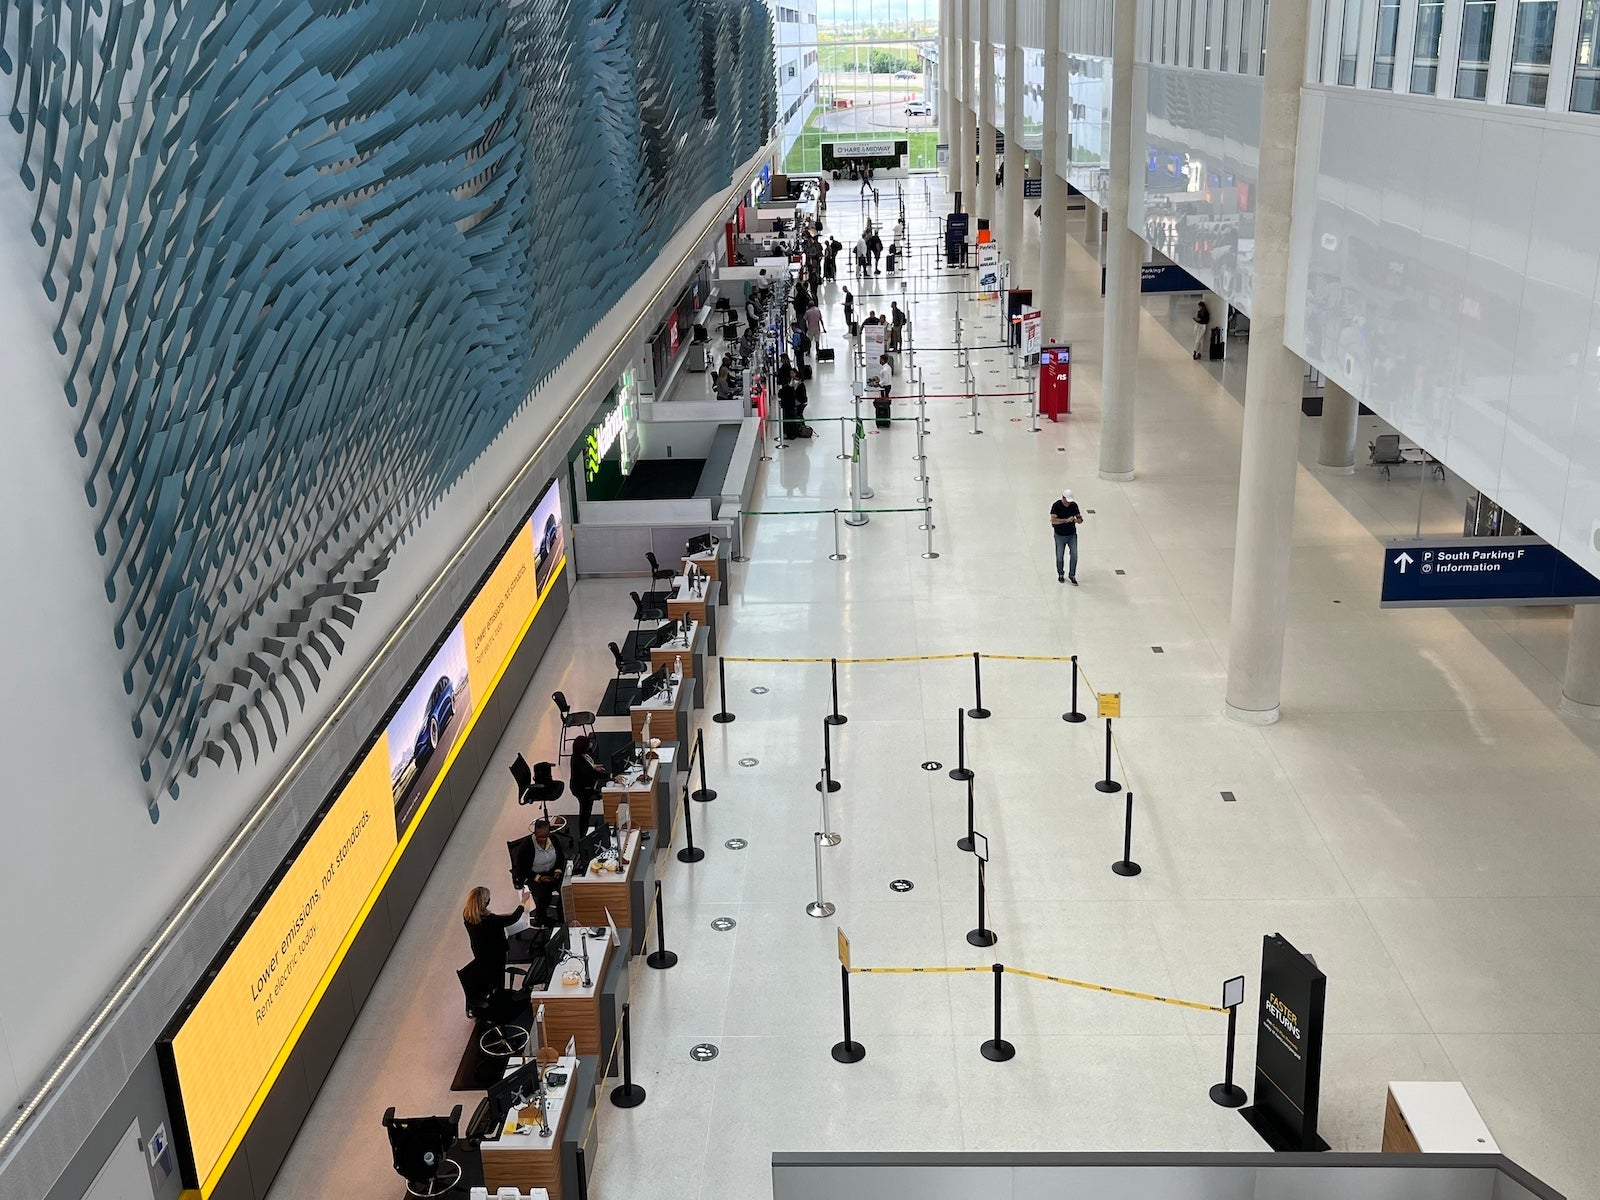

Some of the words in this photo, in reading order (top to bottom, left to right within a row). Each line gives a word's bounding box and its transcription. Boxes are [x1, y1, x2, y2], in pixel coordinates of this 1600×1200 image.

[1436, 562, 1501, 572] Information
[1438, 551, 1469, 560] South
[1472, 550, 1515, 560] Parking
[1517, 550, 1525, 558] F
[251, 952, 279, 1001] Lower
[281, 889, 321, 954] emissions,
[321, 863, 335, 890] not
[336, 809, 371, 868] standards.
[255, 993, 274, 1025] Rent
[274, 956, 298, 995] electric
[298, 924, 318, 956] today.
[1266, 1000, 1300, 1040] RETURNS
[1270, 992, 1297, 1025] FASTER
